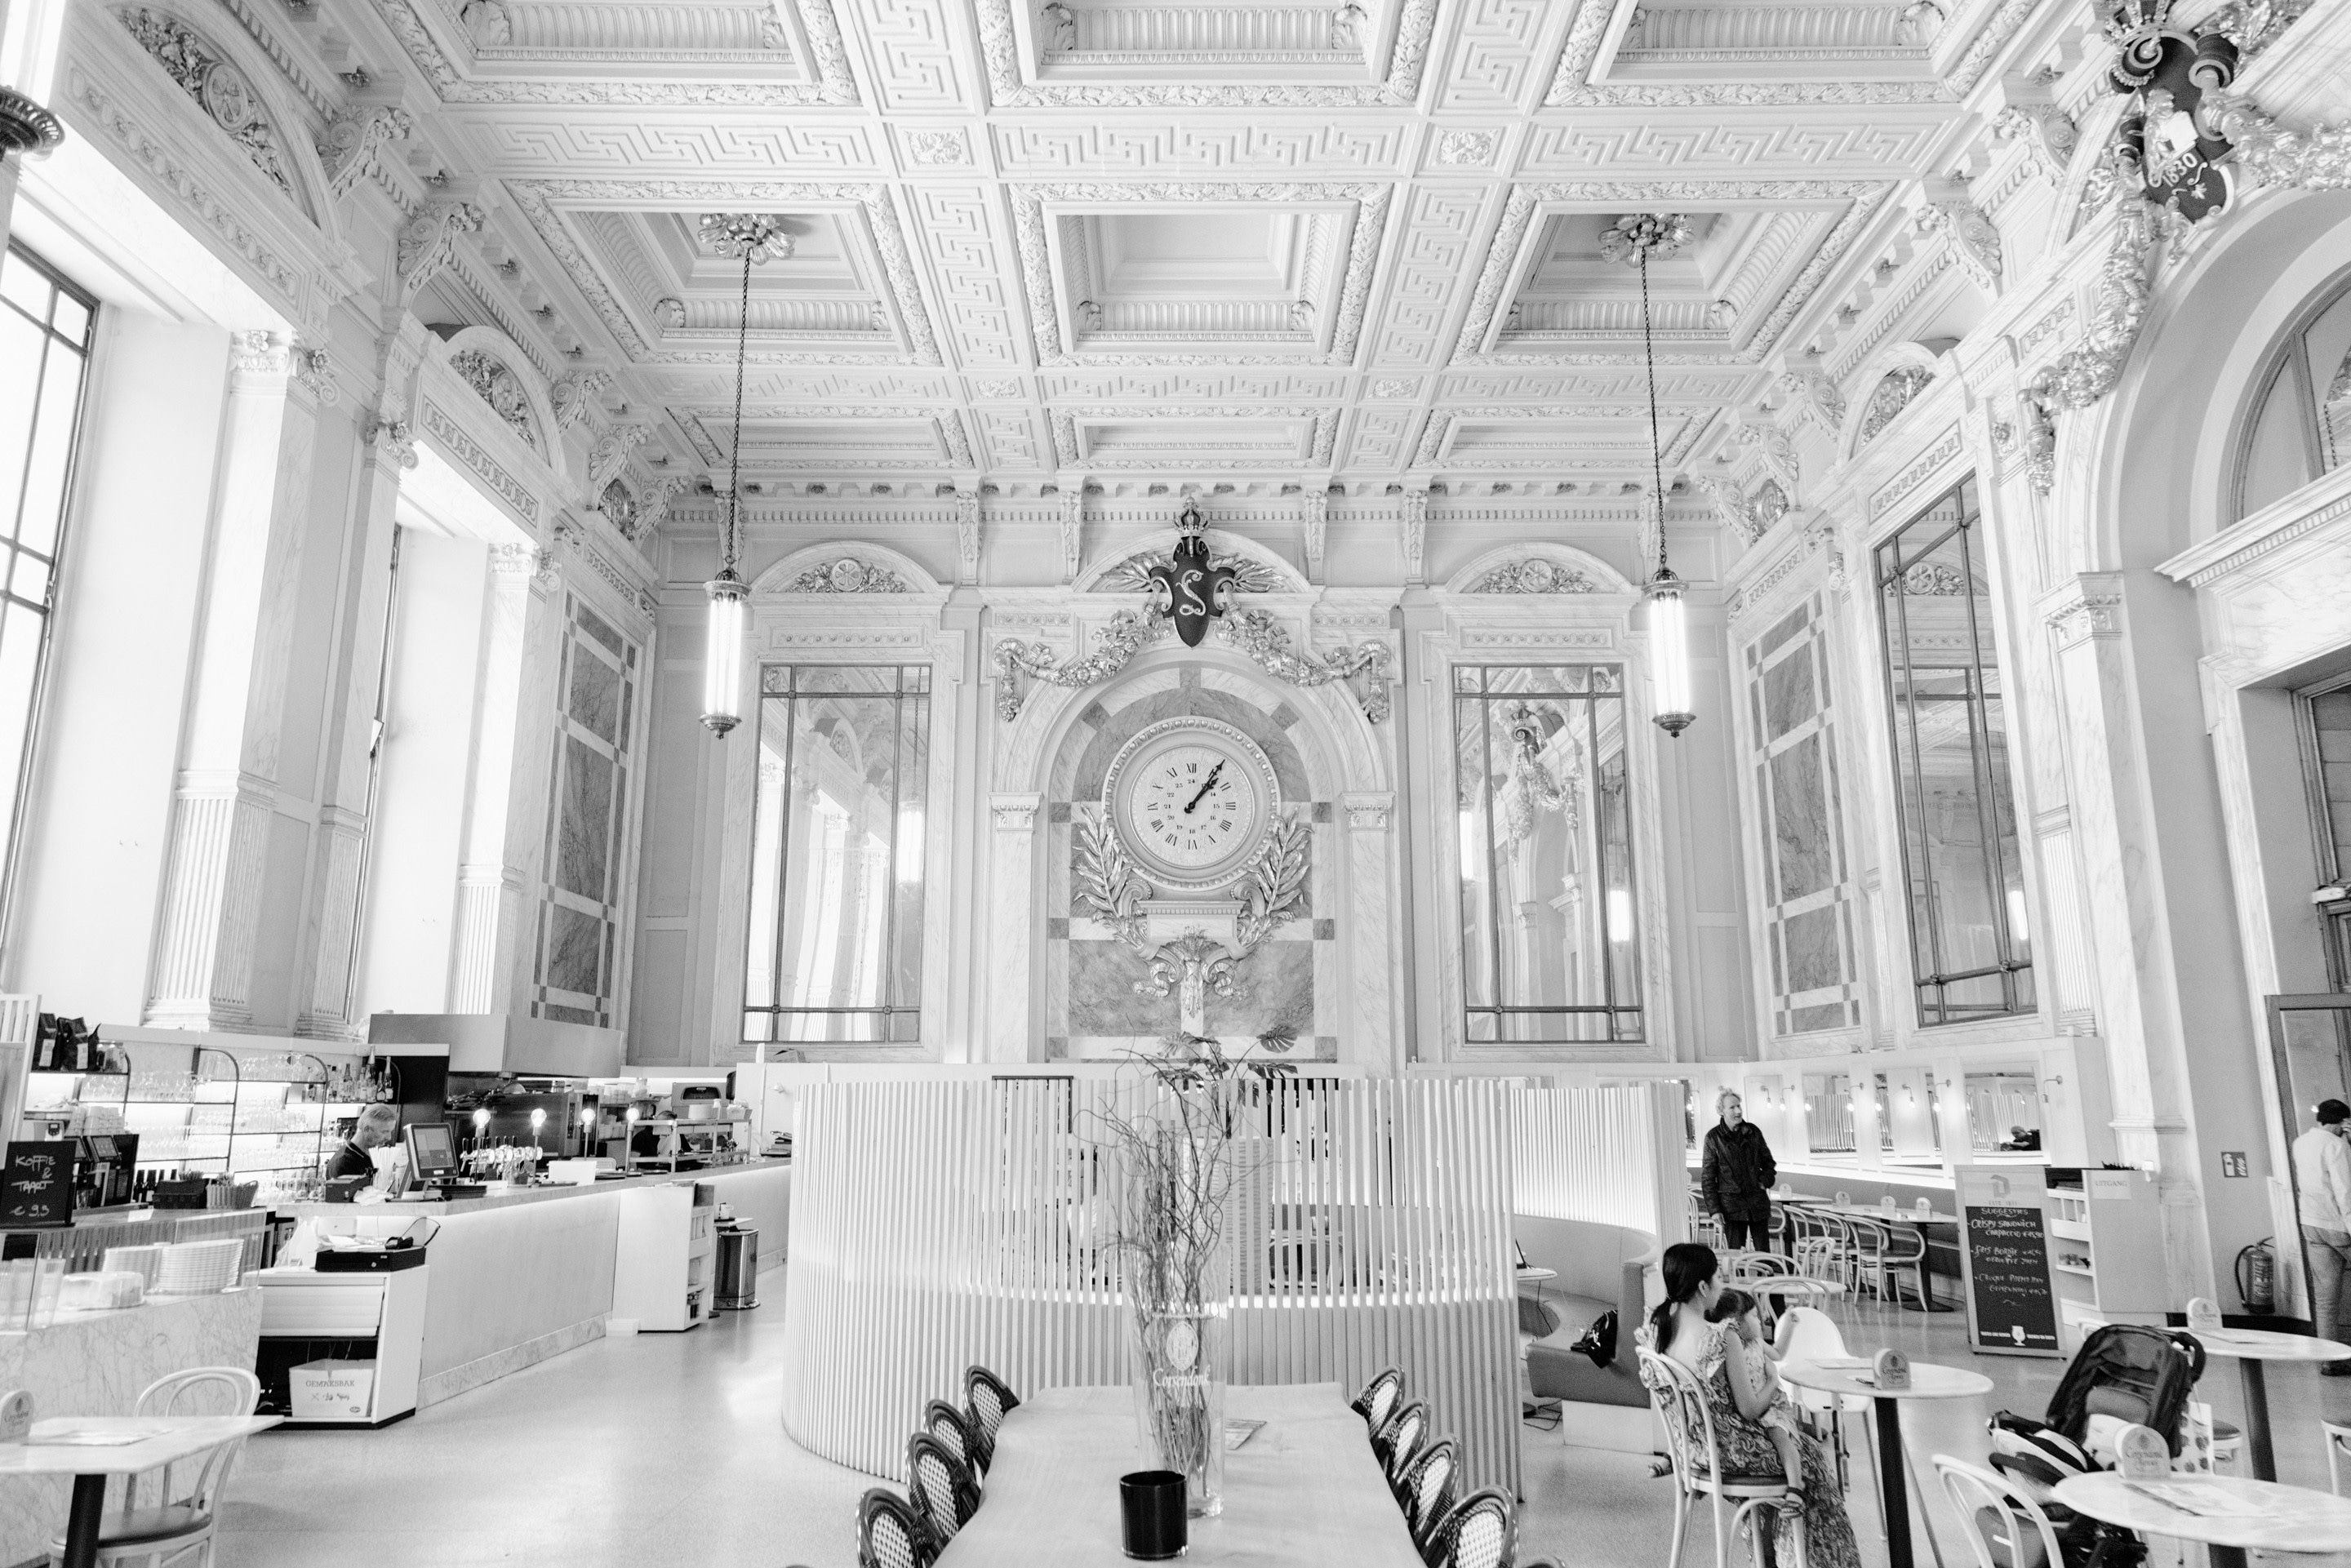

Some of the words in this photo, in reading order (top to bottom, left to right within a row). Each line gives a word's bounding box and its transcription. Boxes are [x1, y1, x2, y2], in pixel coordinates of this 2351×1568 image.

[2162, 153, 2198, 187] 1830
[1166, 767, 1178, 778] XI
[1186, 762, 1197, 774] XII
[1152, 782, 1163, 792] X
[1220, 782, 1231, 792] II
[1147, 802, 1158, 811] IX
[1225, 802, 1236, 811] III
[42, 1166, 52, 1179] &
[1971, 1217, 1997, 1229] CRISPY
[1998, 1219, 2037, 1228] SANDWICH
